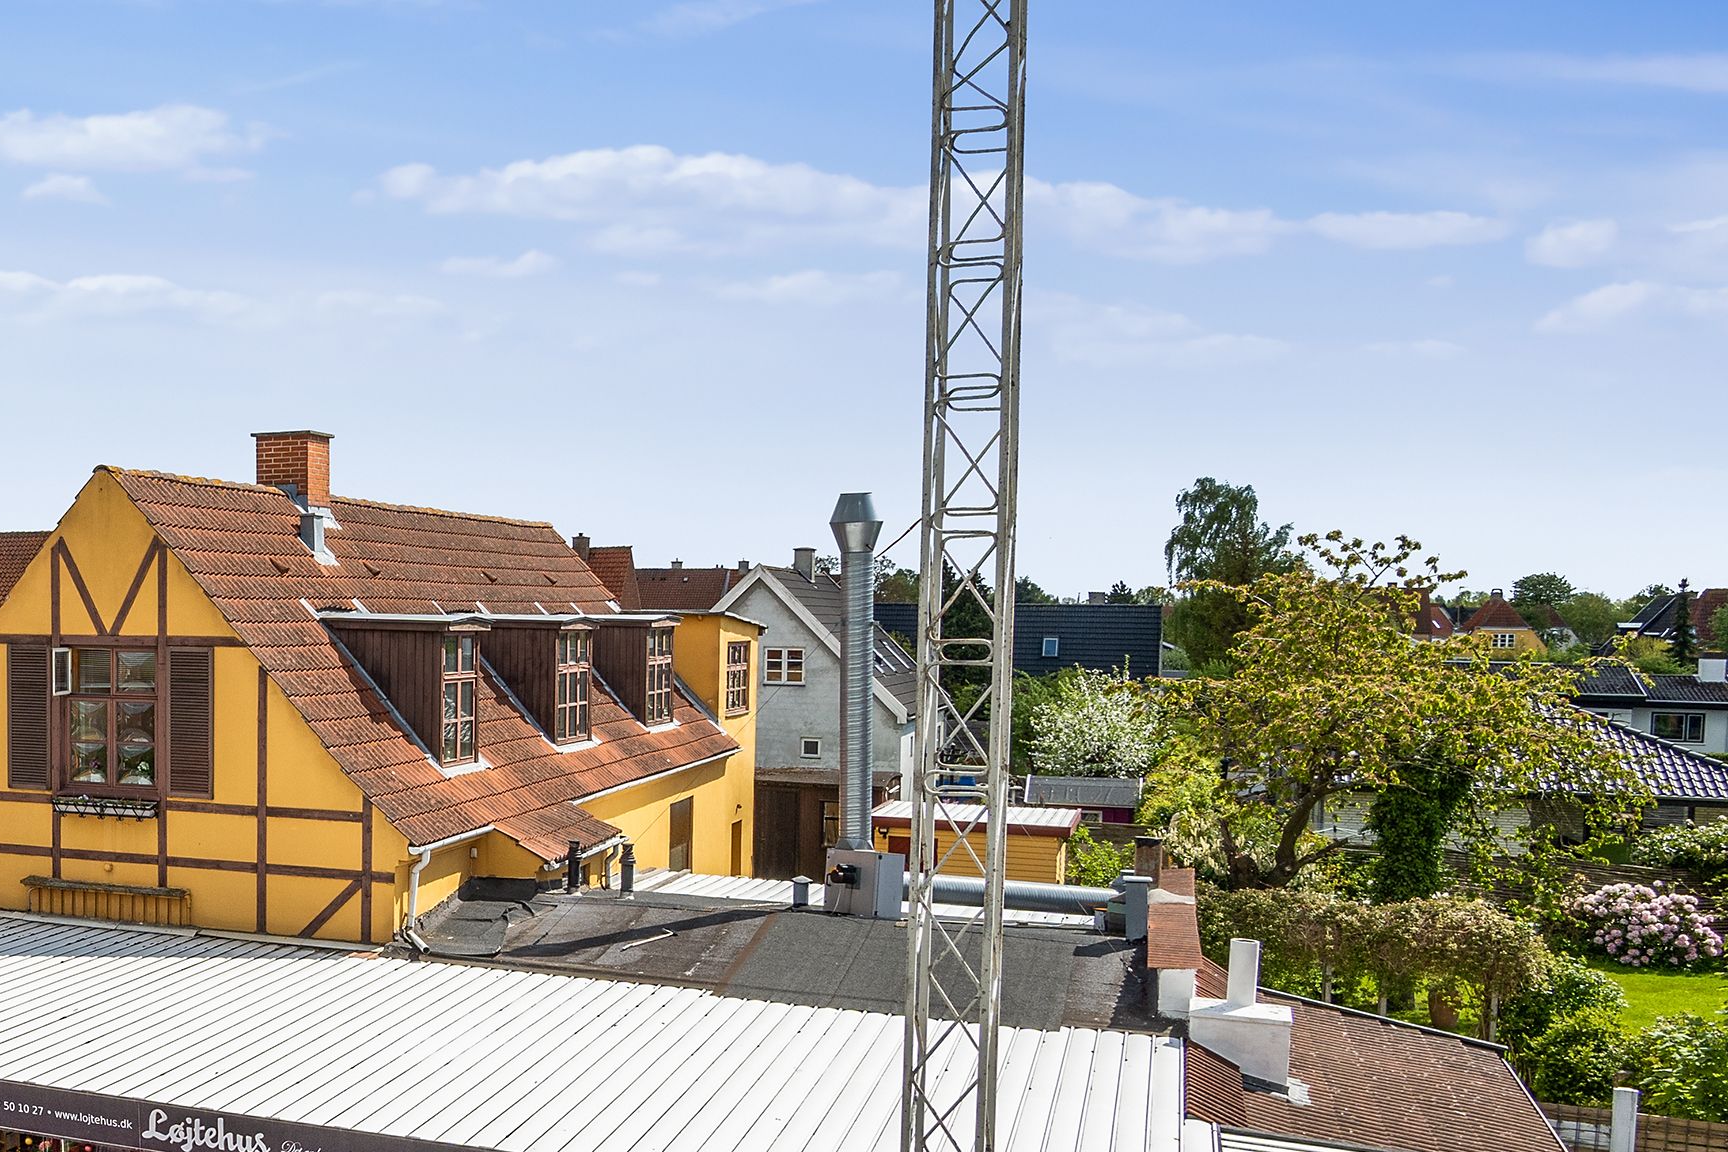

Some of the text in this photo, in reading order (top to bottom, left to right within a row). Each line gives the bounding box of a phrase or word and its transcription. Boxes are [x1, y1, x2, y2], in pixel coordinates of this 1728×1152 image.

[3, 1100, 15, 1112] 50
[17, 1103, 30, 1114] 10
[32, 1105, 44, 1116] 27
[54, 1110, 133, 1130] www.lojtehus.dk
